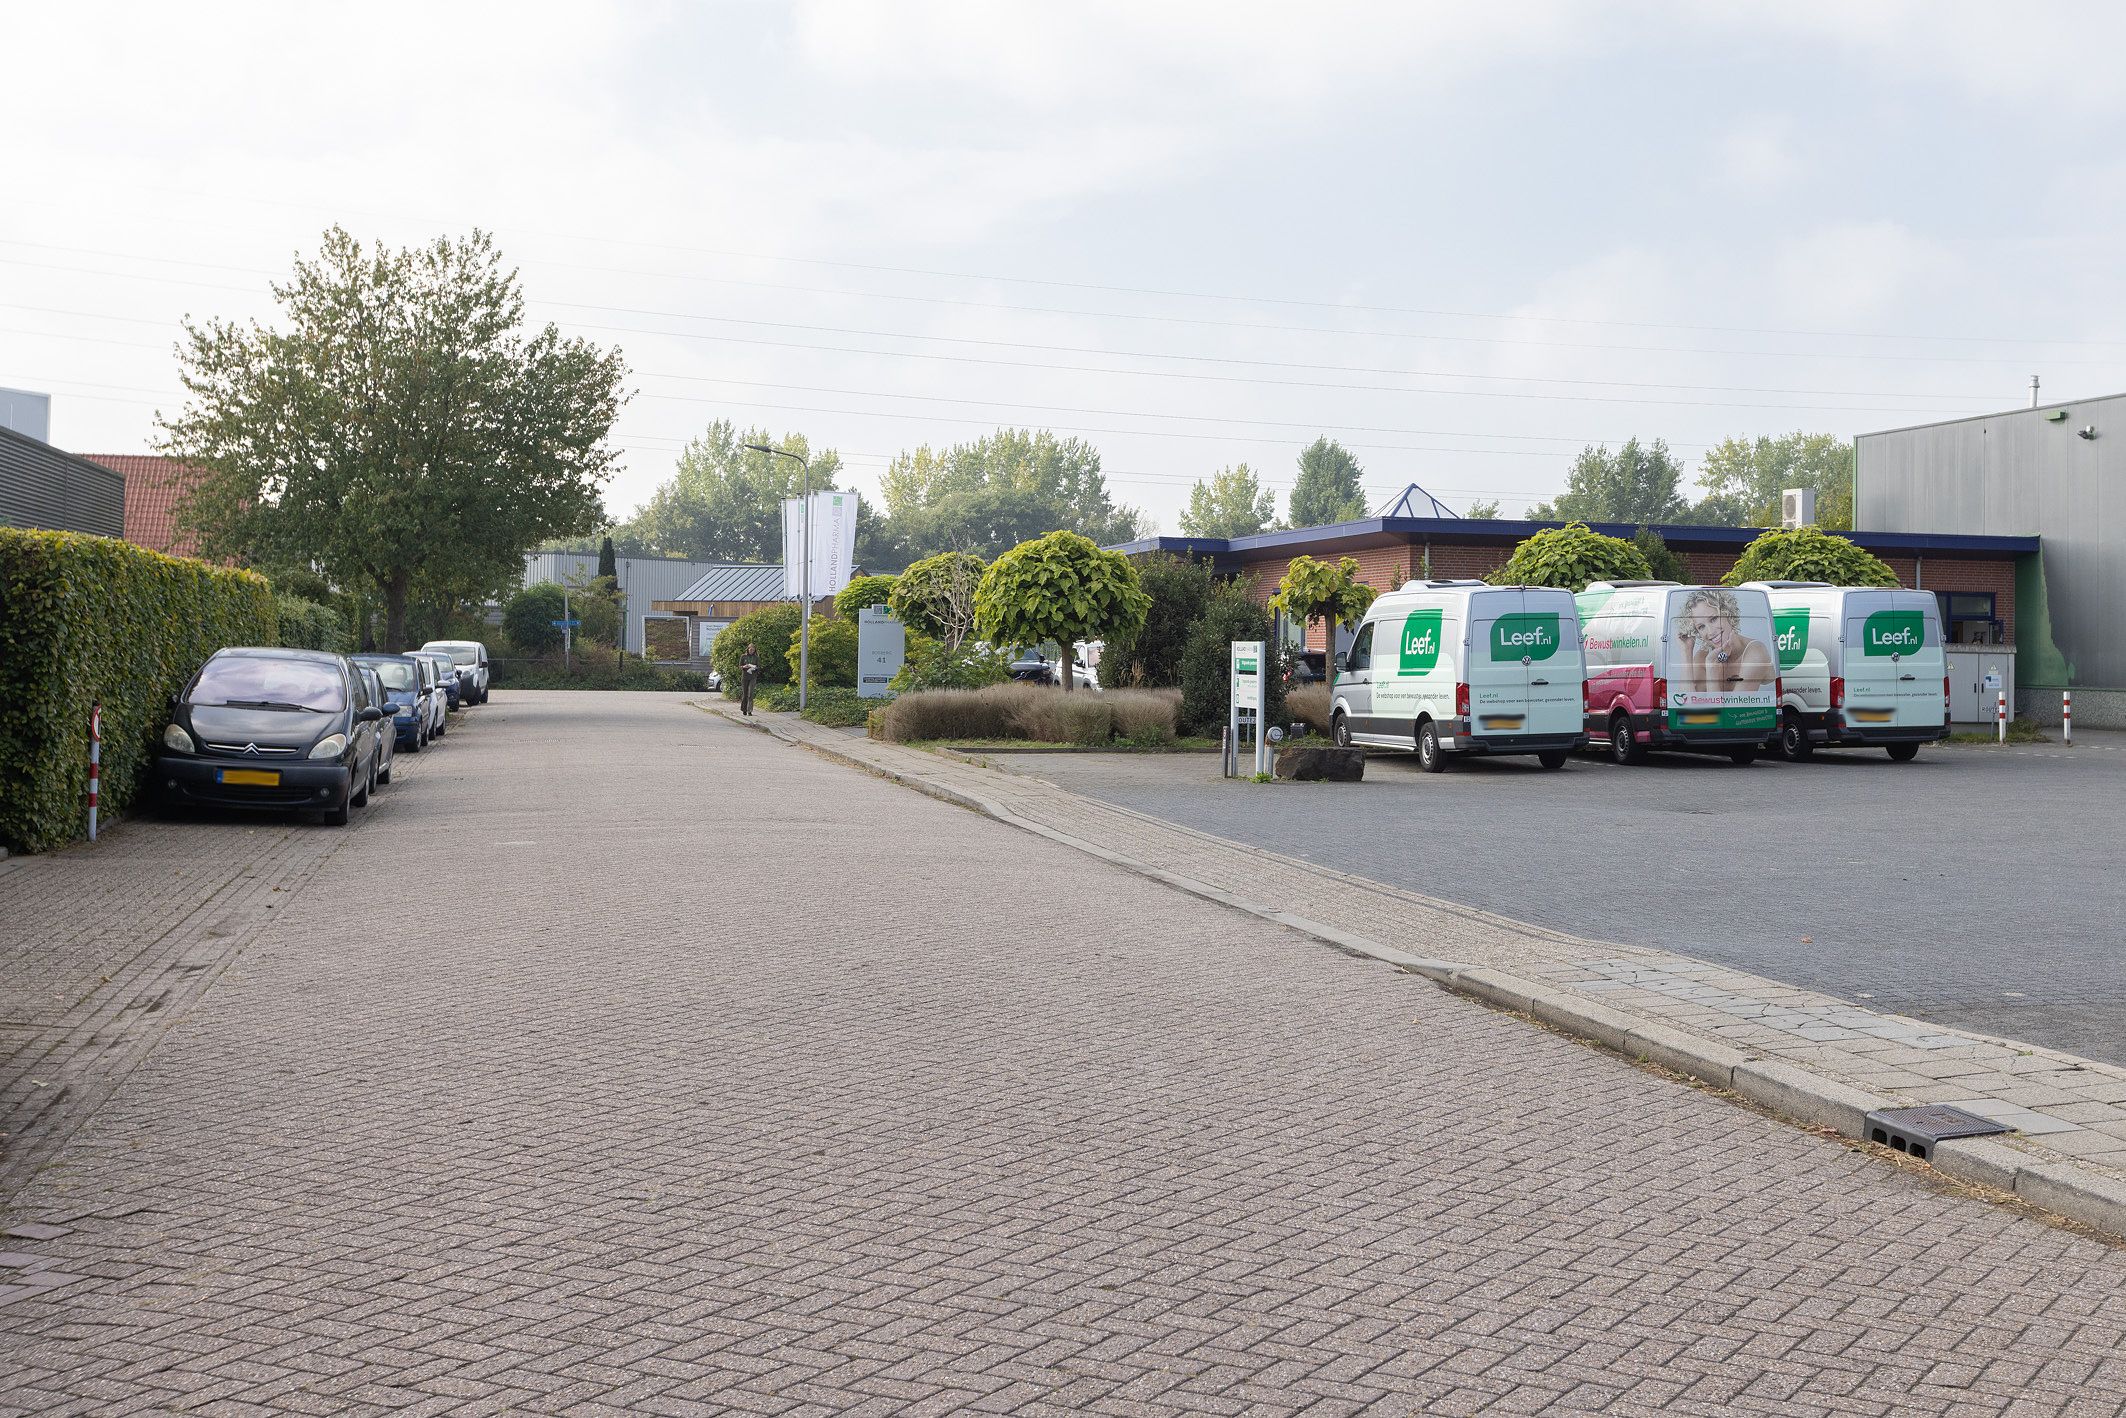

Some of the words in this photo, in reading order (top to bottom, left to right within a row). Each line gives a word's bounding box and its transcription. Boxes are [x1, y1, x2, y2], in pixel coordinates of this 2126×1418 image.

[829, 518, 840, 592] HOLLANDPHARMA
[1405, 629, 1435, 655] Leef.nl
[1501, 626, 1552, 646] Leef.nl
[1590, 635, 1649, 650] Bewustwinkelen.nl
[1778, 626, 1801, 651] ef.nl
[1872, 627, 1918, 645] Leef.nl
[1691, 695, 1771, 704] Bewustwinkelen.nl
